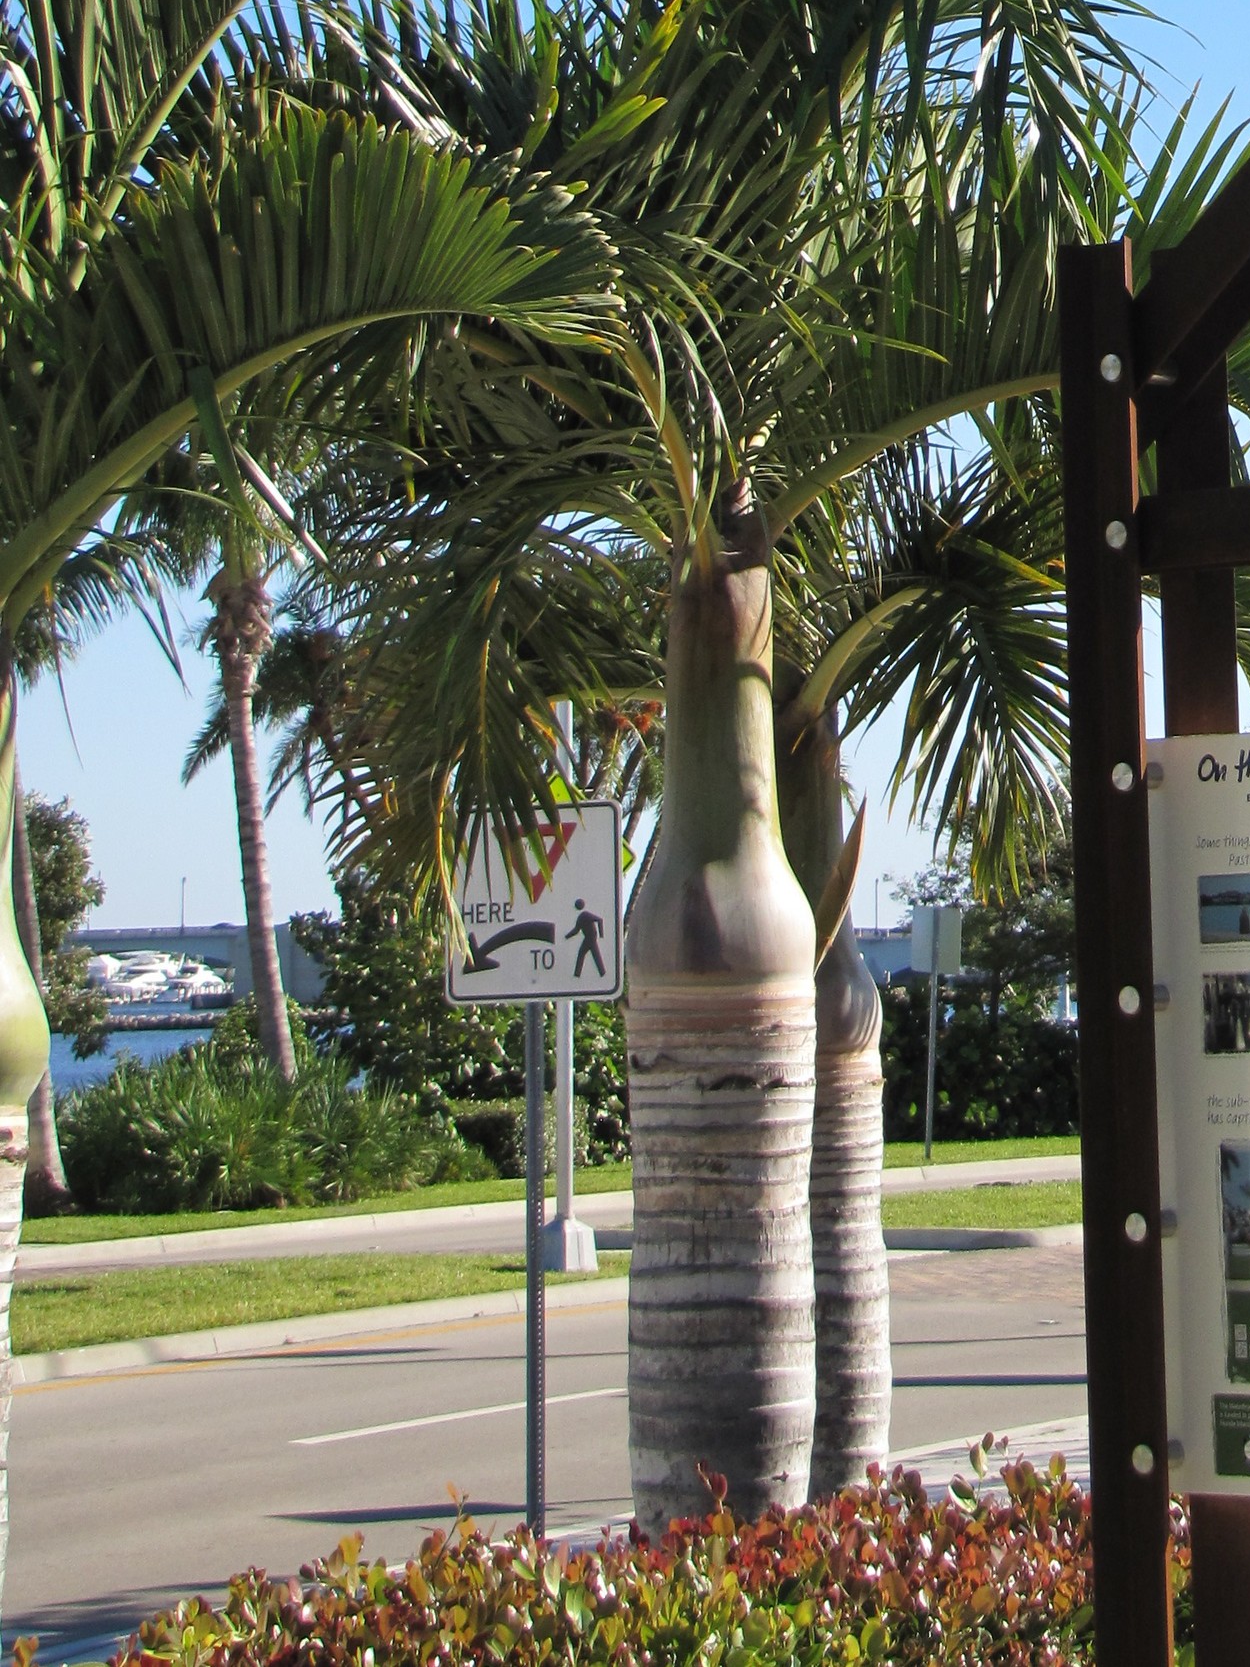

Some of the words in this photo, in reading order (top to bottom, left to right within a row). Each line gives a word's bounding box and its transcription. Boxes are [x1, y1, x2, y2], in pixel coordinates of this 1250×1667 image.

[1197, 753, 1227, 782] On
[1196, 835, 1221, 849] Some
[461, 902, 515, 925] HERE
[530, 948, 556, 971] TO
[1207, 1093, 1224, 1108] the
[1207, 1110, 1224, 1125] has
